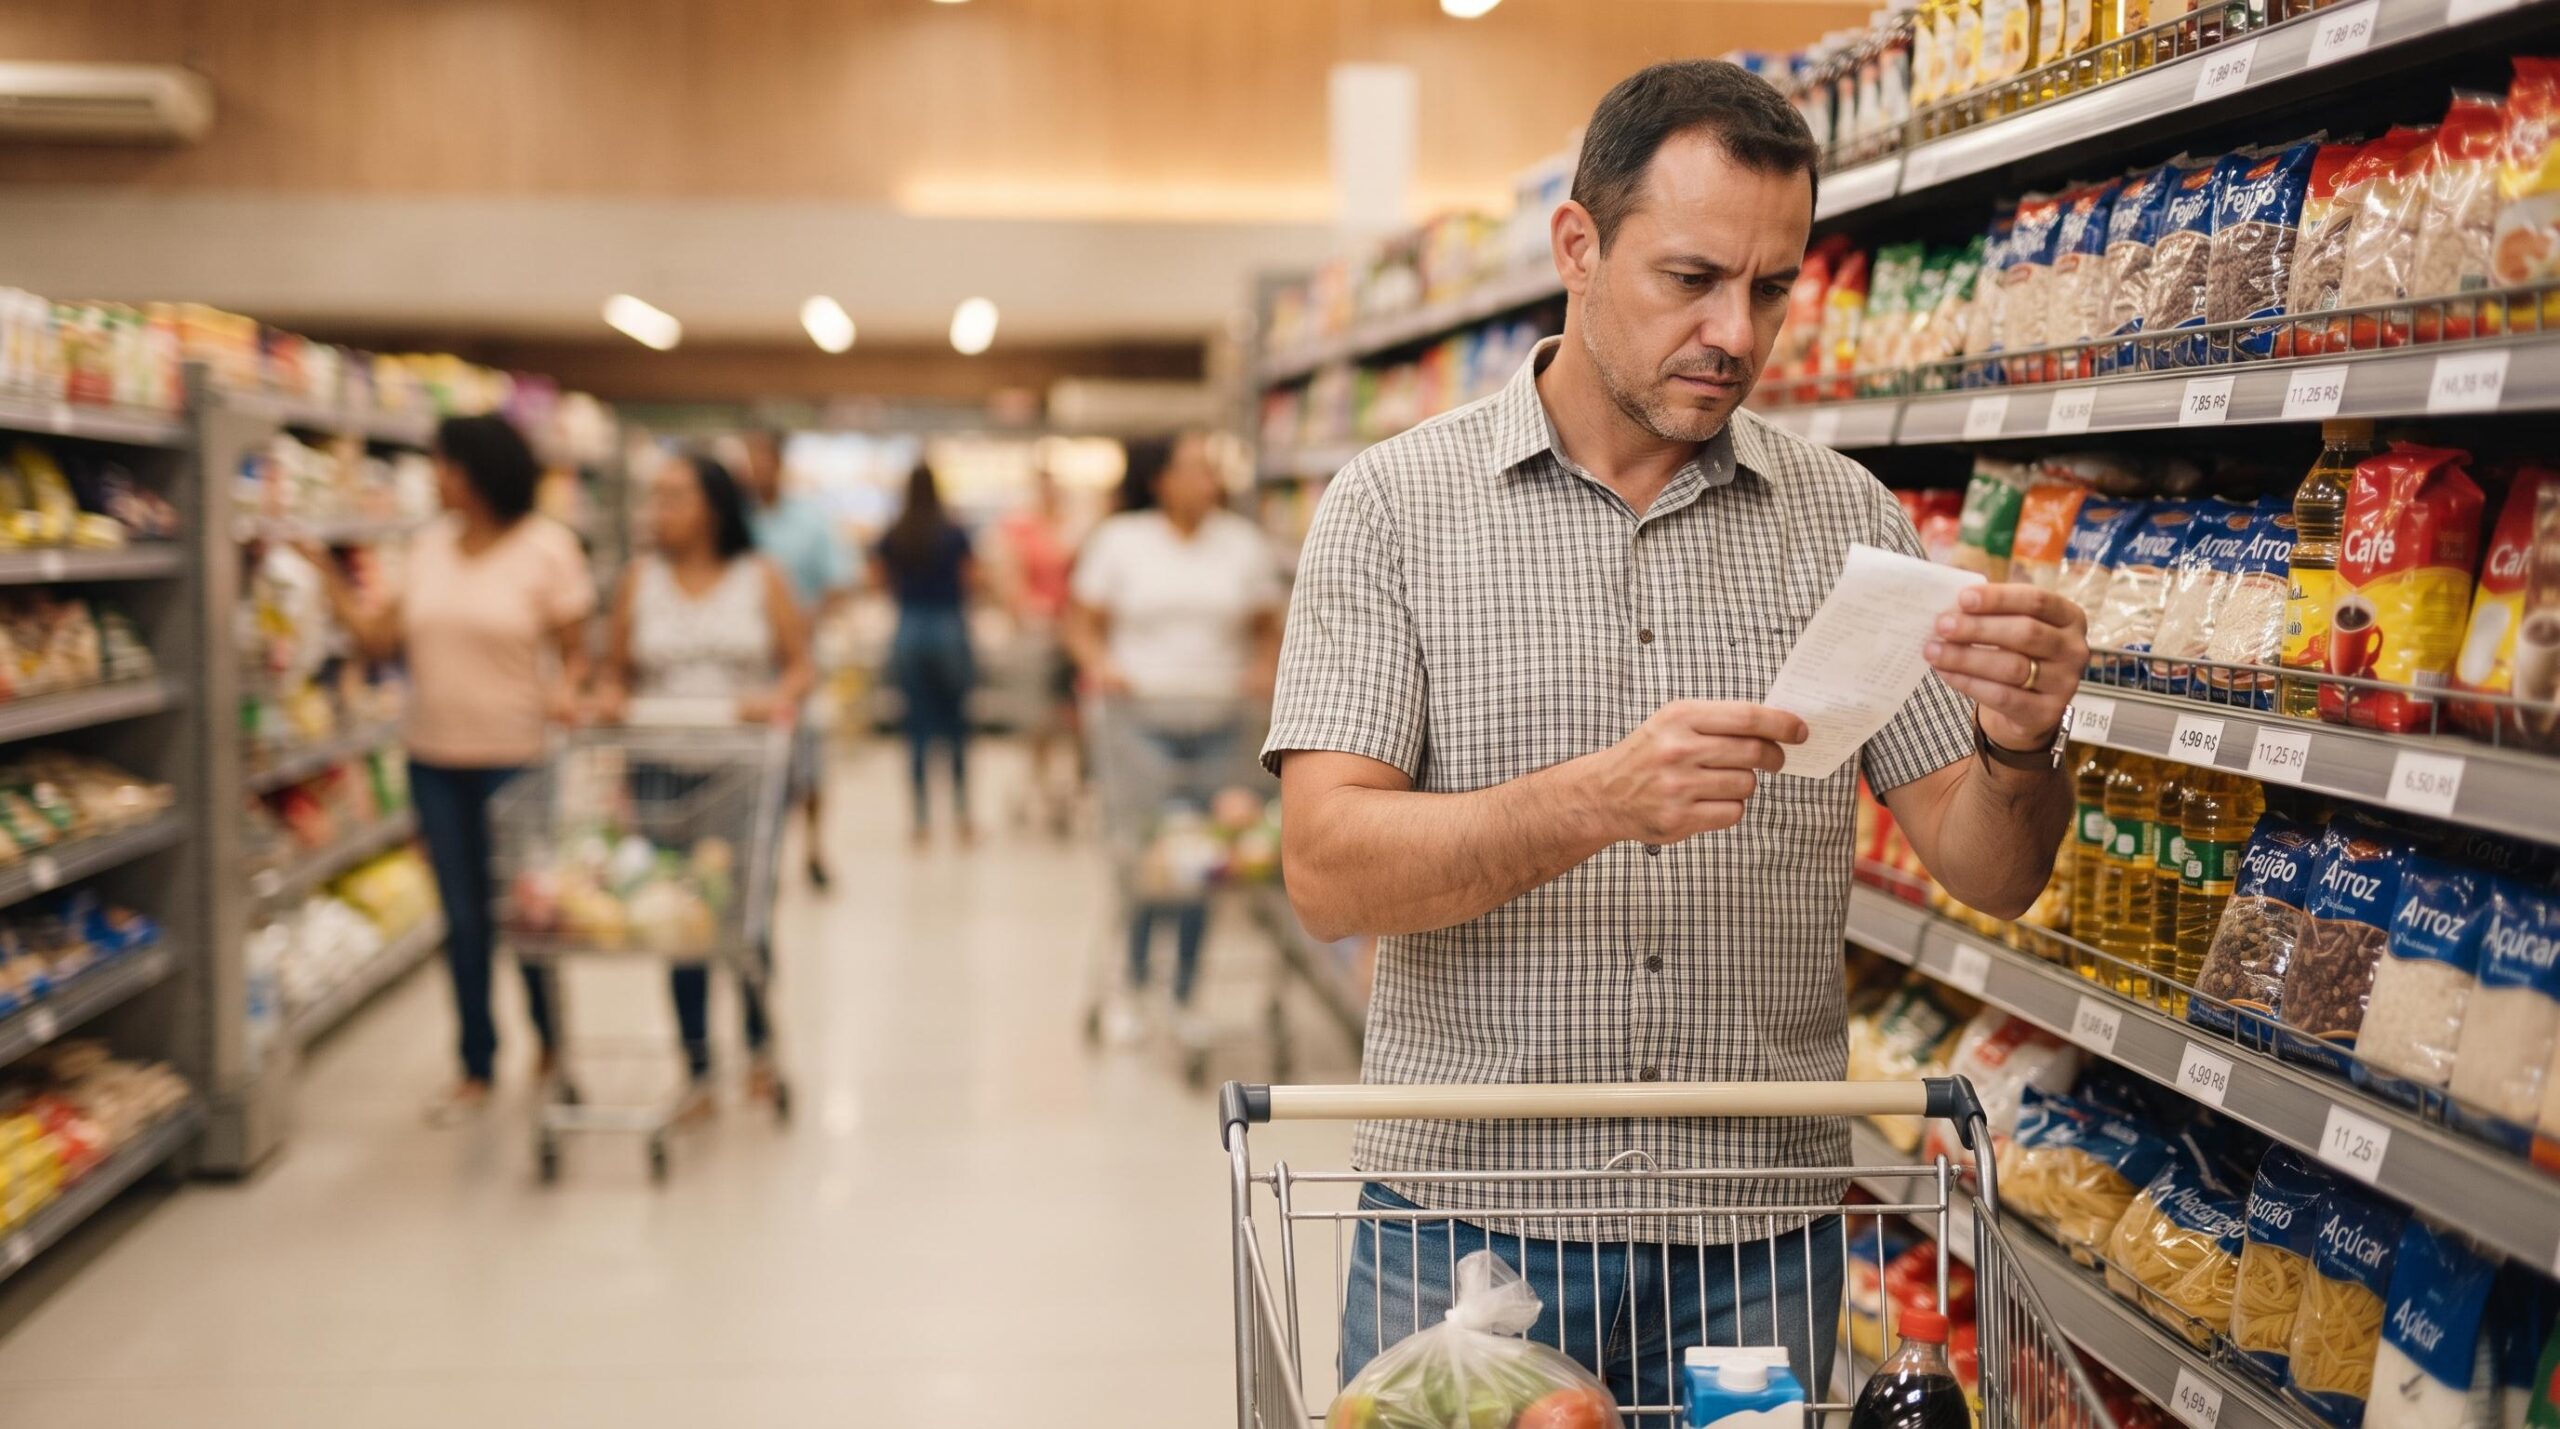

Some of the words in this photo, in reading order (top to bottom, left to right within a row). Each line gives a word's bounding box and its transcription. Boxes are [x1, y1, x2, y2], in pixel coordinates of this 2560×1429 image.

[2212, 393, 2227, 410] R$
[2191, 533, 2243, 558] Arroz
[2240, 532, 2291, 563] Arro
[2344, 528, 2396, 570] Café
[2490, 543, 2533, 576] Caf
[2203, 734, 2218, 752] R$
[2258, 743, 2288, 765] 11,25
[2289, 749, 2304, 768] R$
[2405, 770, 2435, 793] 6,50
[2320, 859, 2382, 902] Arroz
[2398, 896, 2466, 941] Arroz
[2188, 1062, 2211, 1085] 4,99
[2334, 1126, 2373, 1162] 11,25
[2319, 1213, 2390, 1269] Açúcar
